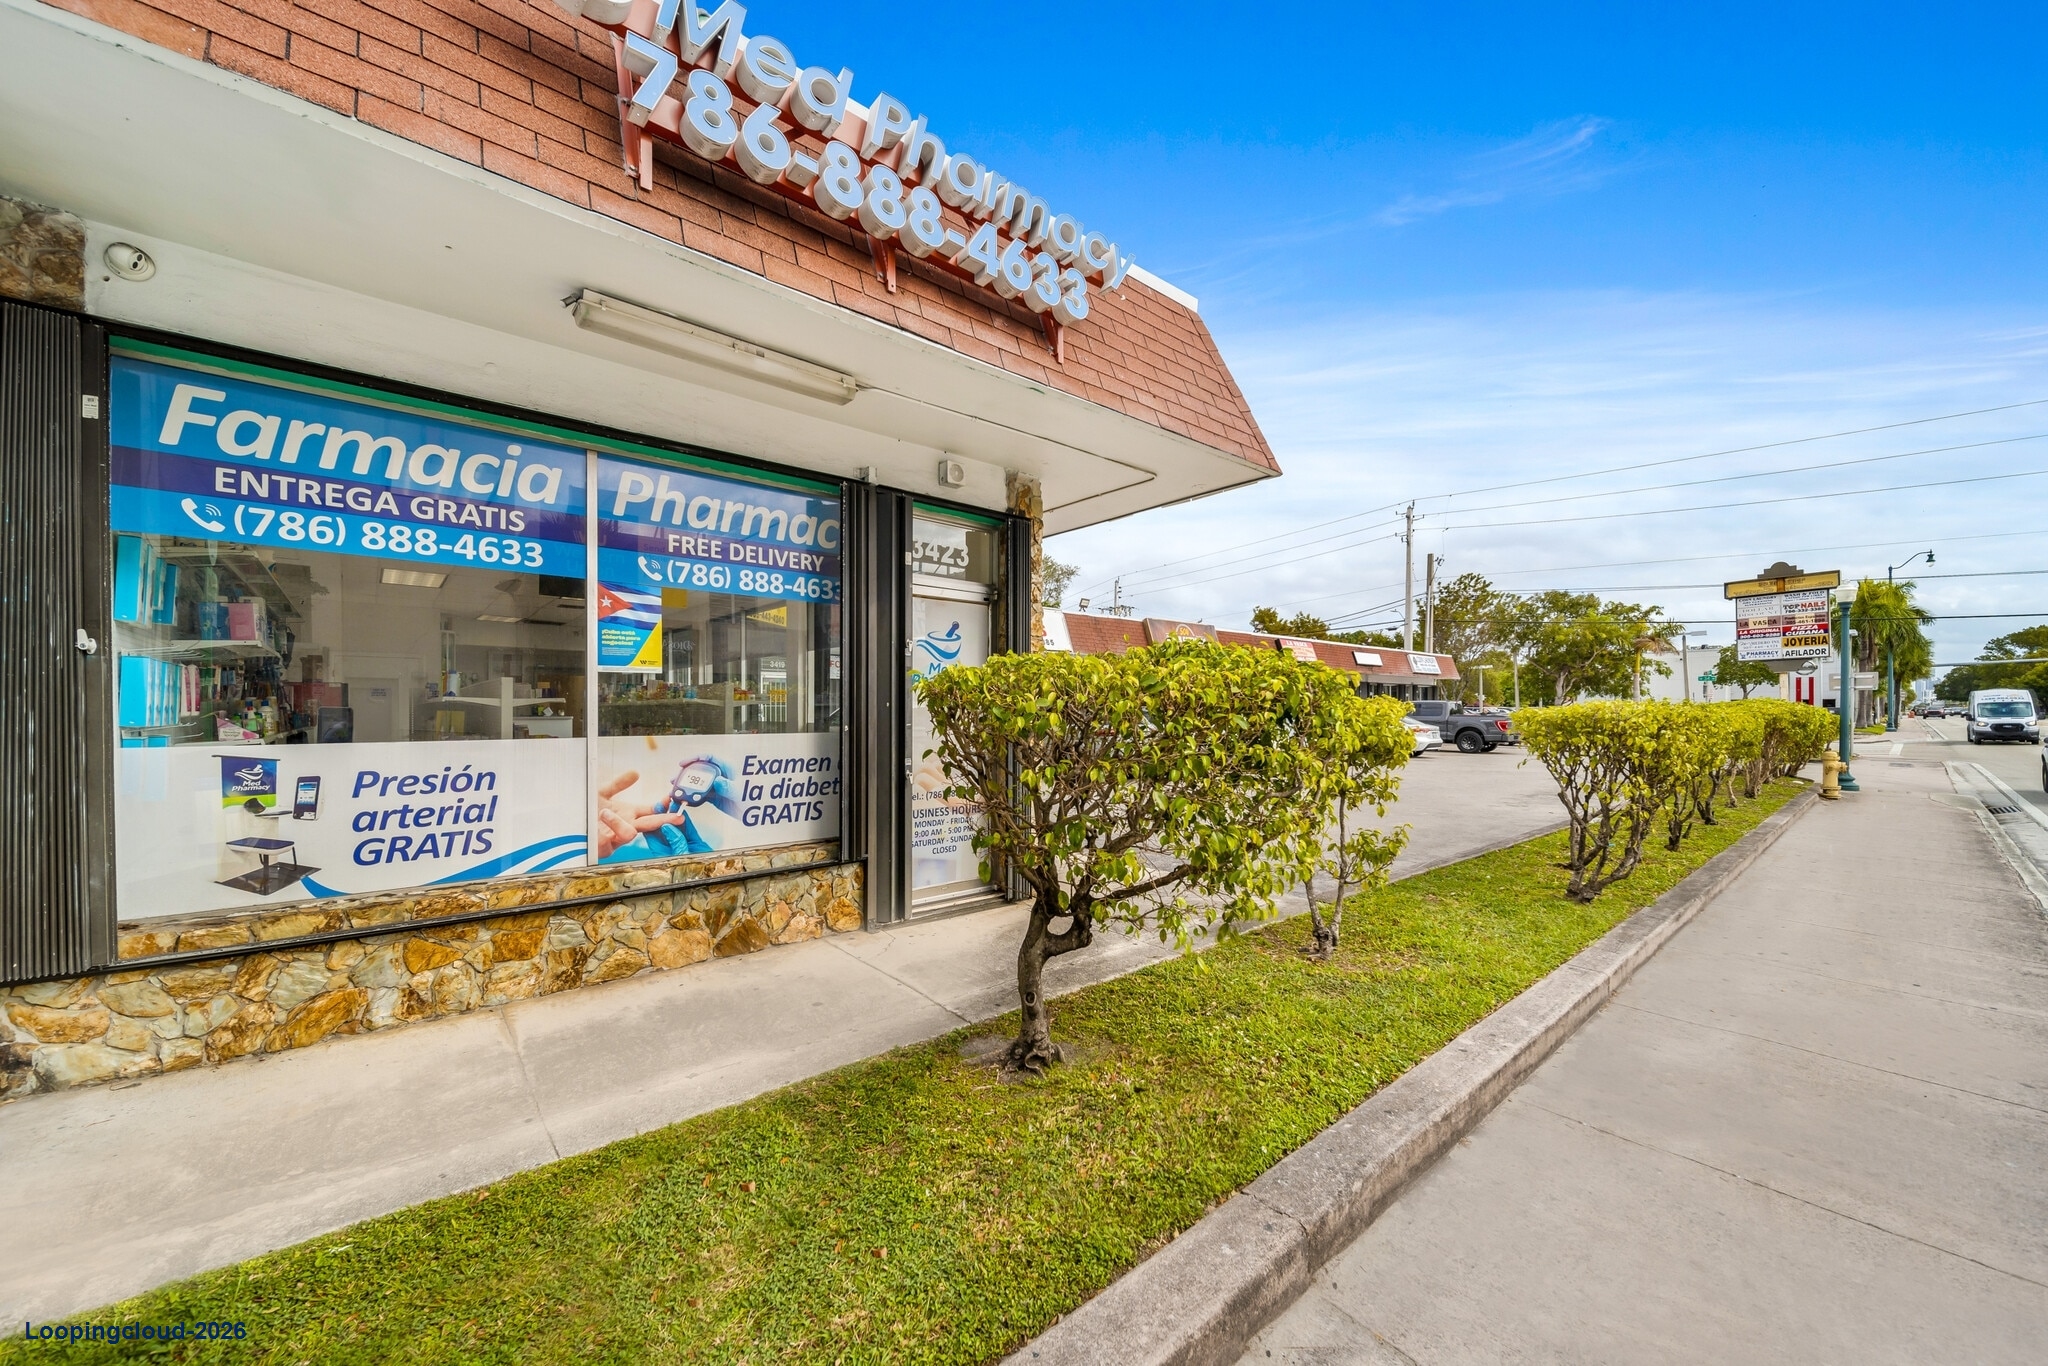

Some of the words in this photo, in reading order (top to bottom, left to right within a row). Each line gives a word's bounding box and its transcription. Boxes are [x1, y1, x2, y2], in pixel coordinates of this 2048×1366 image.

[652, 0, 855, 126] Med
[861, 91, 1136, 292] Pharmacy
[622, 30, 1090, 325] 786-888-4633
[158, 383, 562, 504] Farmacia
[214, 466, 400, 515] ENTREGA
[410, 496, 526, 532] GRATIS
[233, 504, 347, 547] (786)
[360, 520, 544, 568] 888-4633
[668, 533, 722, 559] FREE
[729, 543, 824, 572] DELIVERY
[912, 537, 970, 567] 3423
[666, 559, 731, 589] (786)
[1800, 601, 1826, 609] NAILS
[1784, 635, 1828, 647] JOYERIA
[1785, 648, 1827, 657] AFILADOR
[769, 660, 785, 668] 3419
[741, 754, 831, 776] Examen
[231, 784, 271, 792] Pharmacy
[351, 763, 497, 799] Presión
[741, 779, 763, 801] la
[770, 774, 841, 800] diabet
[351, 795, 498, 833] arterial
[742, 800, 824, 827] GRATIS
[914, 818, 946, 829] MONDAY
[914, 829, 930, 839] 9:00
[930, 828, 943, 836] AM
[947, 825, 962, 835] 5:00
[352, 828, 495, 866] GRATIS
[932, 845, 957, 855] CLOSED
